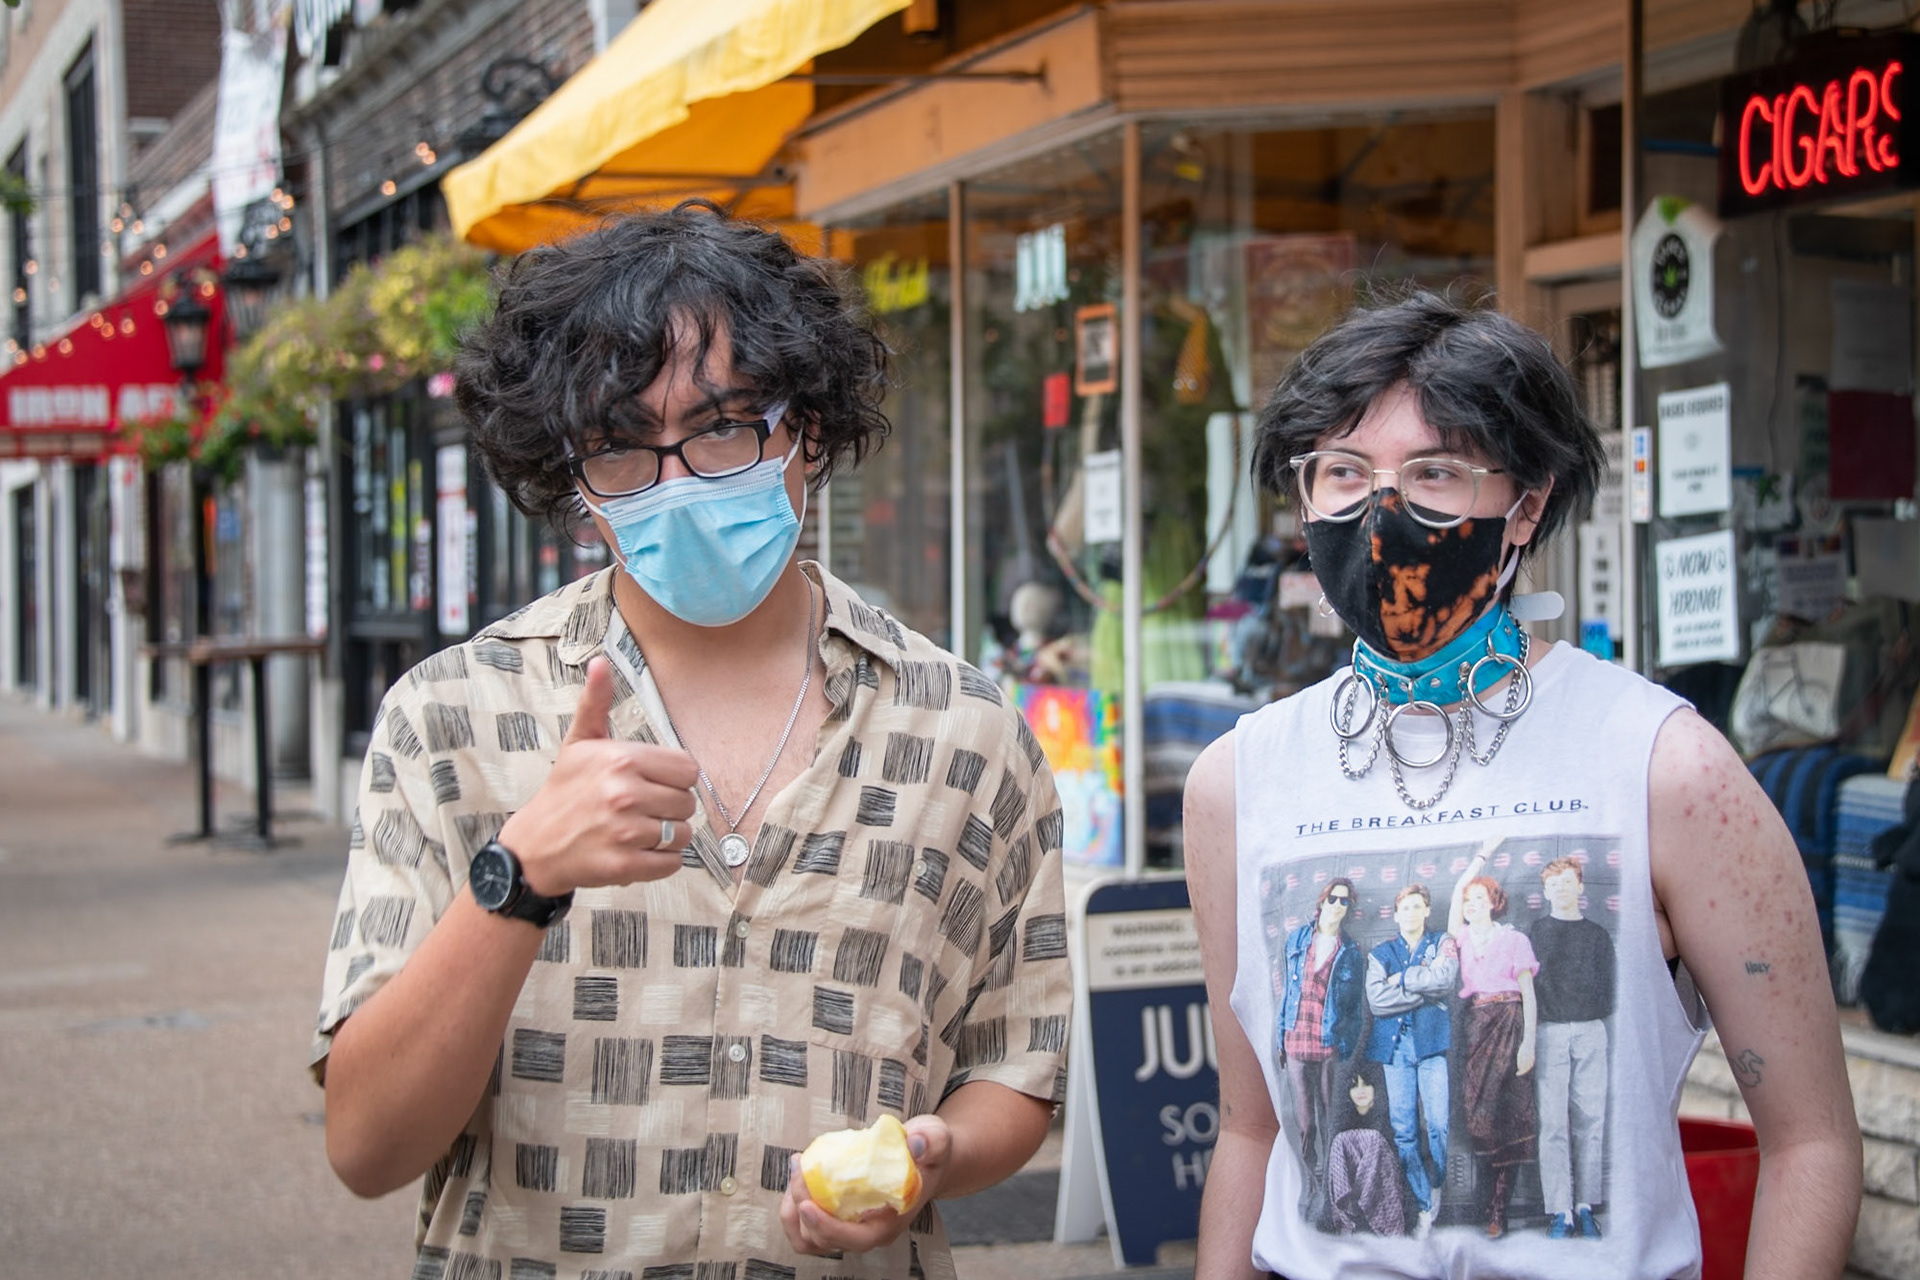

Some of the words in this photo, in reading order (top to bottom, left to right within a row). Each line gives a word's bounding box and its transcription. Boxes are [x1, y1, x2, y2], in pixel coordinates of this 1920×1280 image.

[1677, 551, 1712, 577] NOW
[1668, 585, 1722, 616] HIRING!
[1296, 820, 1340, 836] THE
[1351, 805, 1500, 829] BREAKFAST
